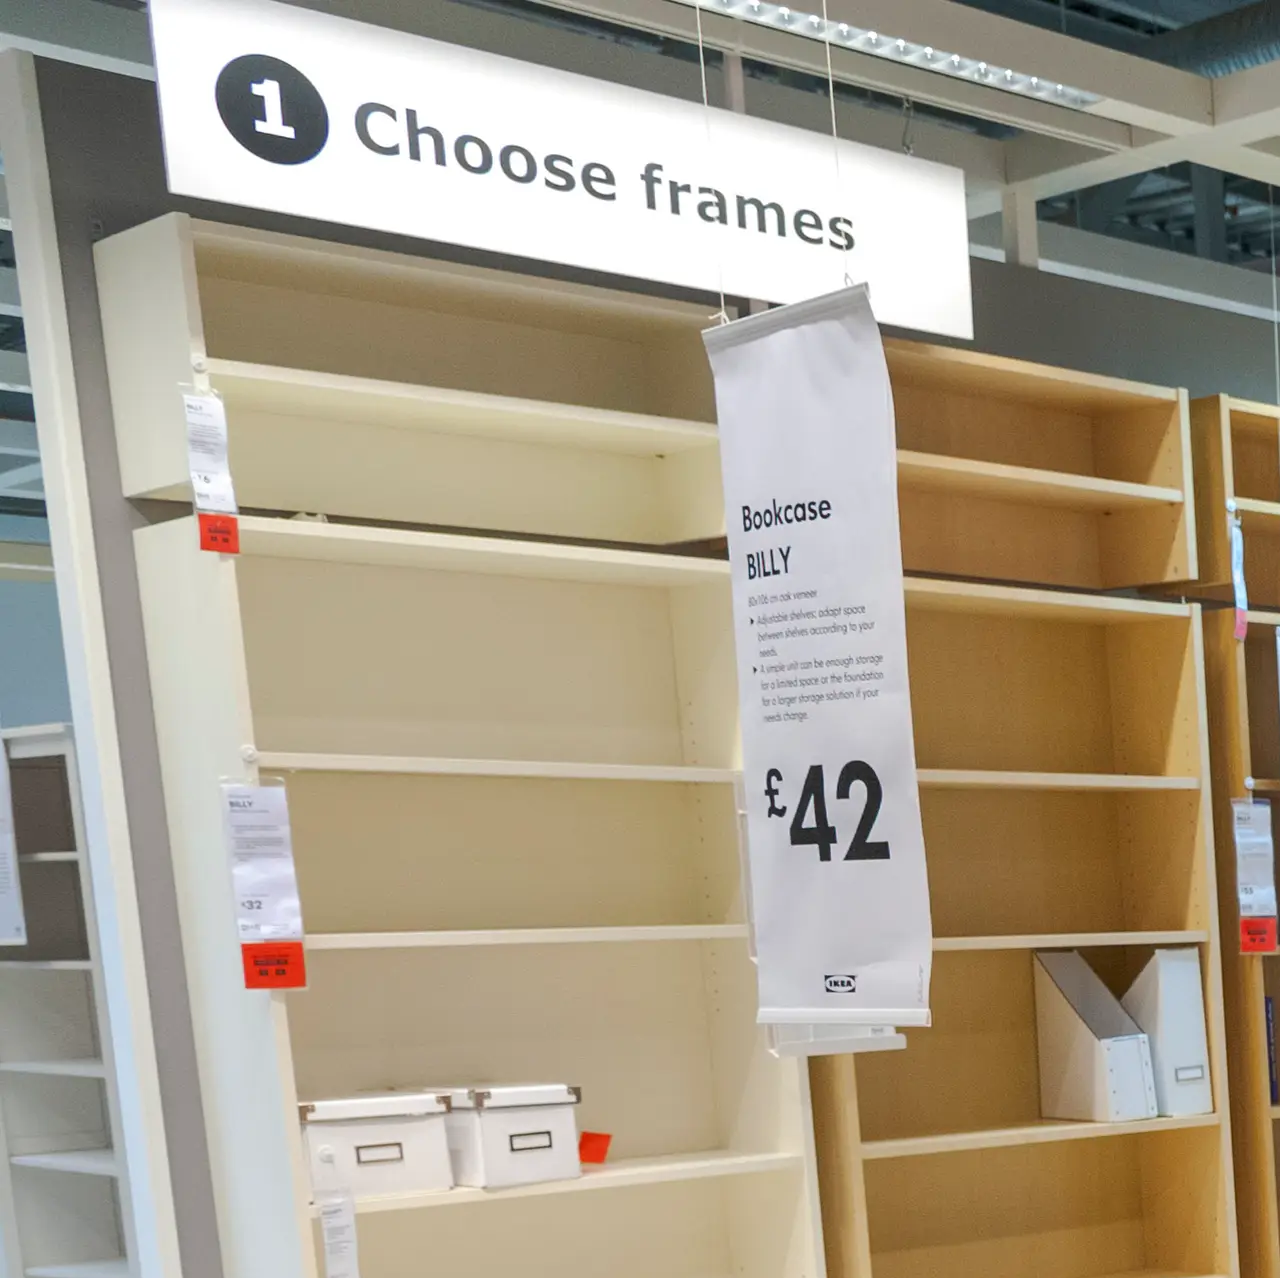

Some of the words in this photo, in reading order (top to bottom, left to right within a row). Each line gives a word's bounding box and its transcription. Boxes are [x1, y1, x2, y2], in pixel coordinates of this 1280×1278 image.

[250, 78, 297, 140] 1
[353, 101, 617, 201] Choose
[640, 162, 855, 251] frames
[742, 498, 832, 532] Bookcase
[747, 546, 792, 580] BILLY
[843, 605, 866, 617] space
[809, 622, 848, 635] according
[849, 622, 857, 632] to
[858, 621, 875, 633] your
[813, 657, 824, 668] be
[825, 654, 854, 668] enough
[855, 654, 884, 666] storage
[862, 689, 879, 700] your
[764, 760, 891, 862] £42
